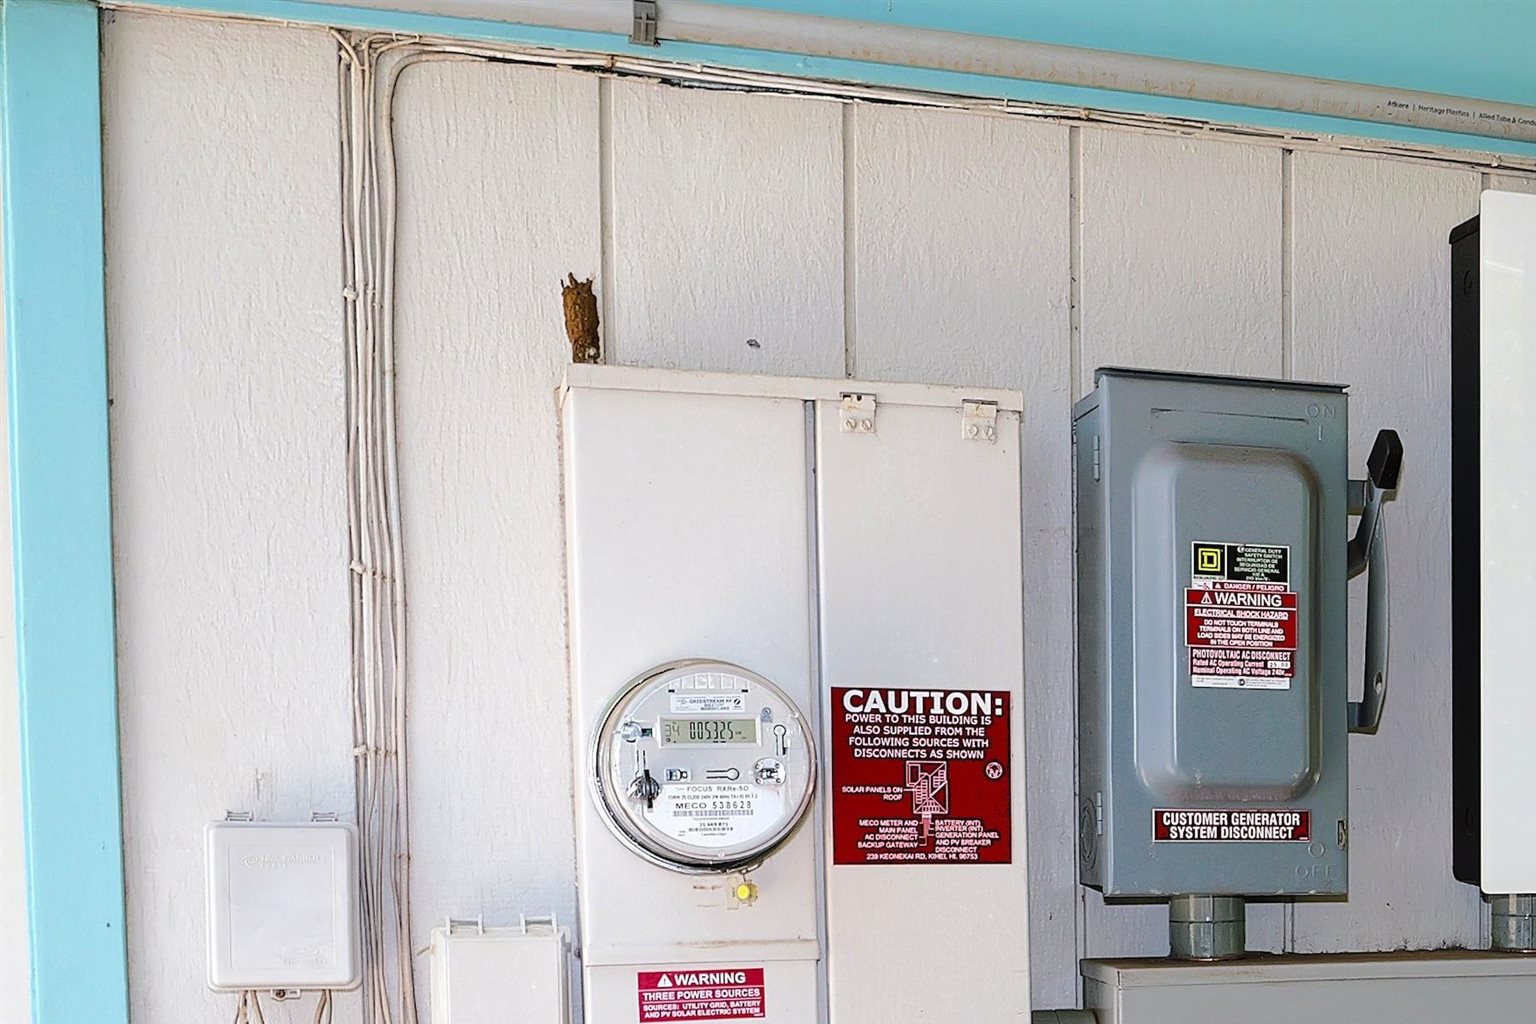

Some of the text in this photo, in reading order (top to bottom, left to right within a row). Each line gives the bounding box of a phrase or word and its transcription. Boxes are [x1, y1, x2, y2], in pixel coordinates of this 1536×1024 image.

[1419, 104, 1445, 115] Heritage
[1446, 108, 1469, 117] Plastics
[1305, 403, 1336, 418] ON
[1214, 592, 1282, 607] WARNING
[1194, 609, 1288, 619] ELECTRICAL SHOCK HAZARD
[1192, 649, 1291, 660] PHOTOVOLTAIC AC DISCONNECT
[843, 690, 1003, 716] CAUTION:
[845, 714, 991, 725] POWER TO THIS BUILDING IS
[690, 722, 733, 739] 005325
[853, 725, 985, 736] ALSO SUPPLIED FROM THE
[849, 737, 988, 748] FOLLOWING SOURCES WITH
[854, 749, 984, 759] DISCONNECTS AS SHOWN
[675, 801, 752, 810] MECO 538628
[1163, 812, 1300, 826] CUSTOMER GENERATOR
[1170, 826, 1294, 839] SYSTEM DISCONNECT
[674, 972, 746, 986] WARNING
[643, 988, 760, 1001] THREE POWER SOURCES
[682, 1002, 708, 1010] UTILITY
